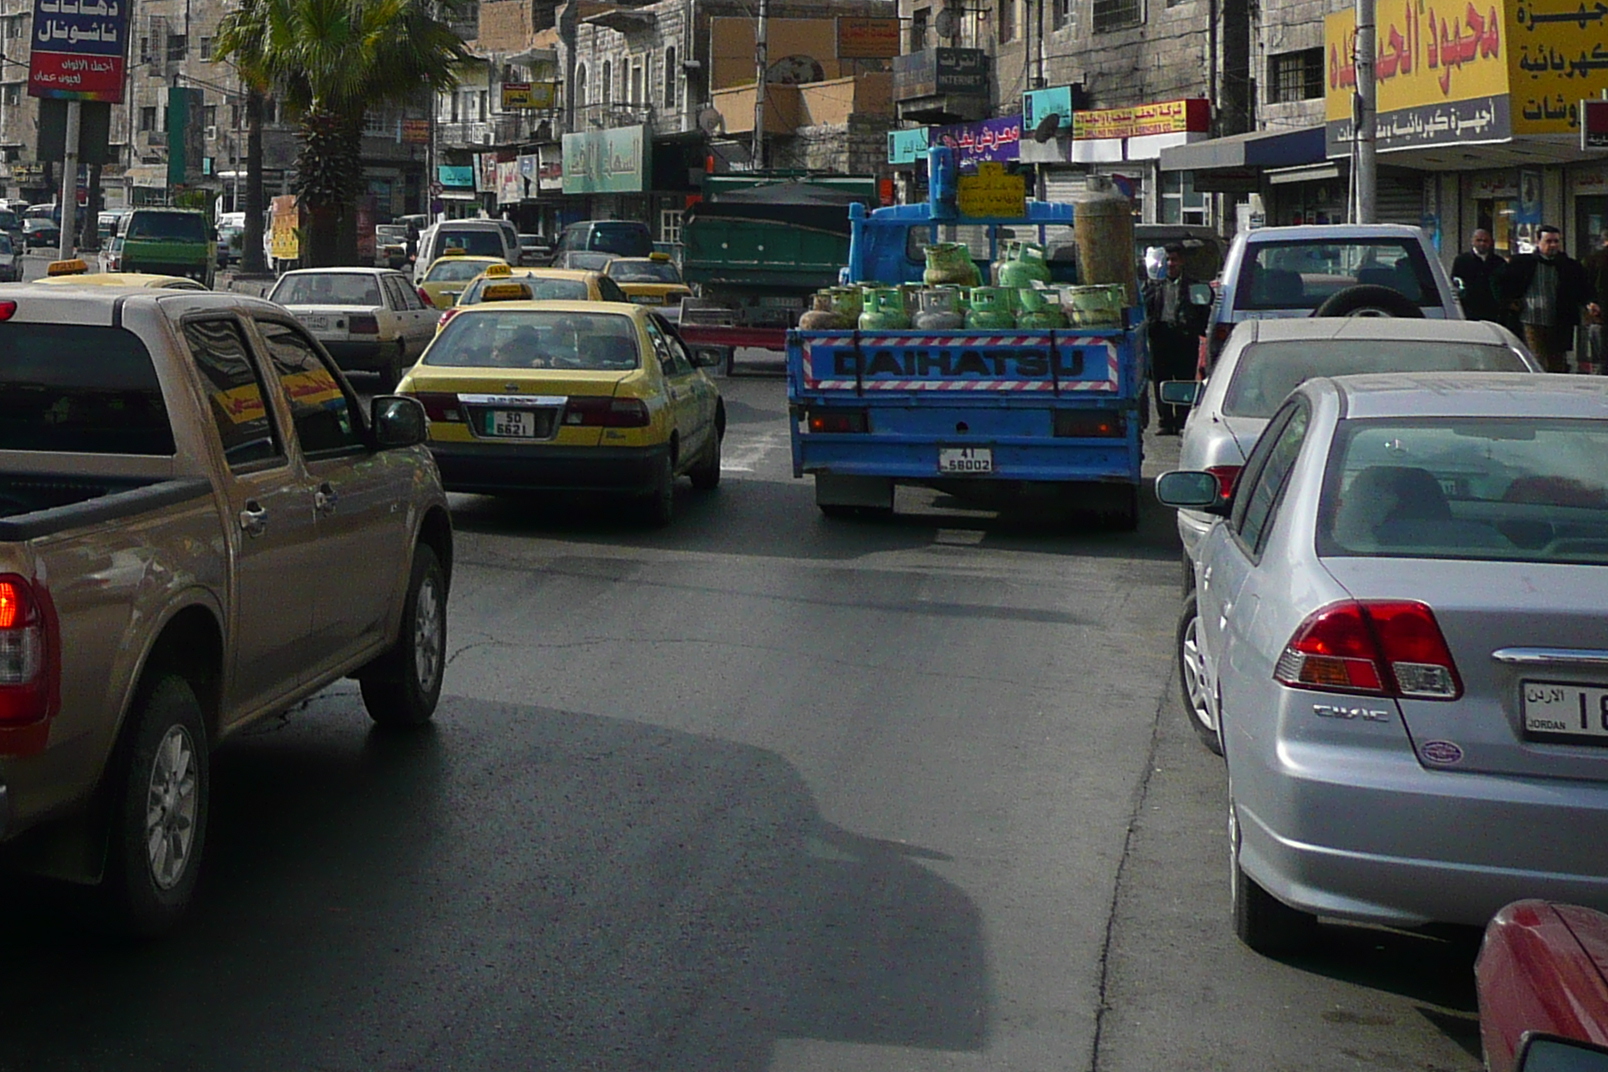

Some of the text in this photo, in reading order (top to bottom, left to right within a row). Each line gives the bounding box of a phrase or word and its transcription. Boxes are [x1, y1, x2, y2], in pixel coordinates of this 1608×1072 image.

[38, 19, 117, 43] ناشونال
[1427, 1, 1499, 98] محمود
[34, 70, 57, 82] عمان
[939, 75, 981, 86] INTERNET
[1393, 107, 1449, 140] كهربائية
[1450, 97, 1496, 136] أجهزة
[975, 123, 1021, 154] معرض
[834, 349, 1083, 377] DAIHATSU
[949, 459, 989, 470] 58002
[1526, 689, 1565, 705] الاردن
[1312, 704, 1390, 723] CIVIC
[1528, 718, 1566, 730] JORDAN
